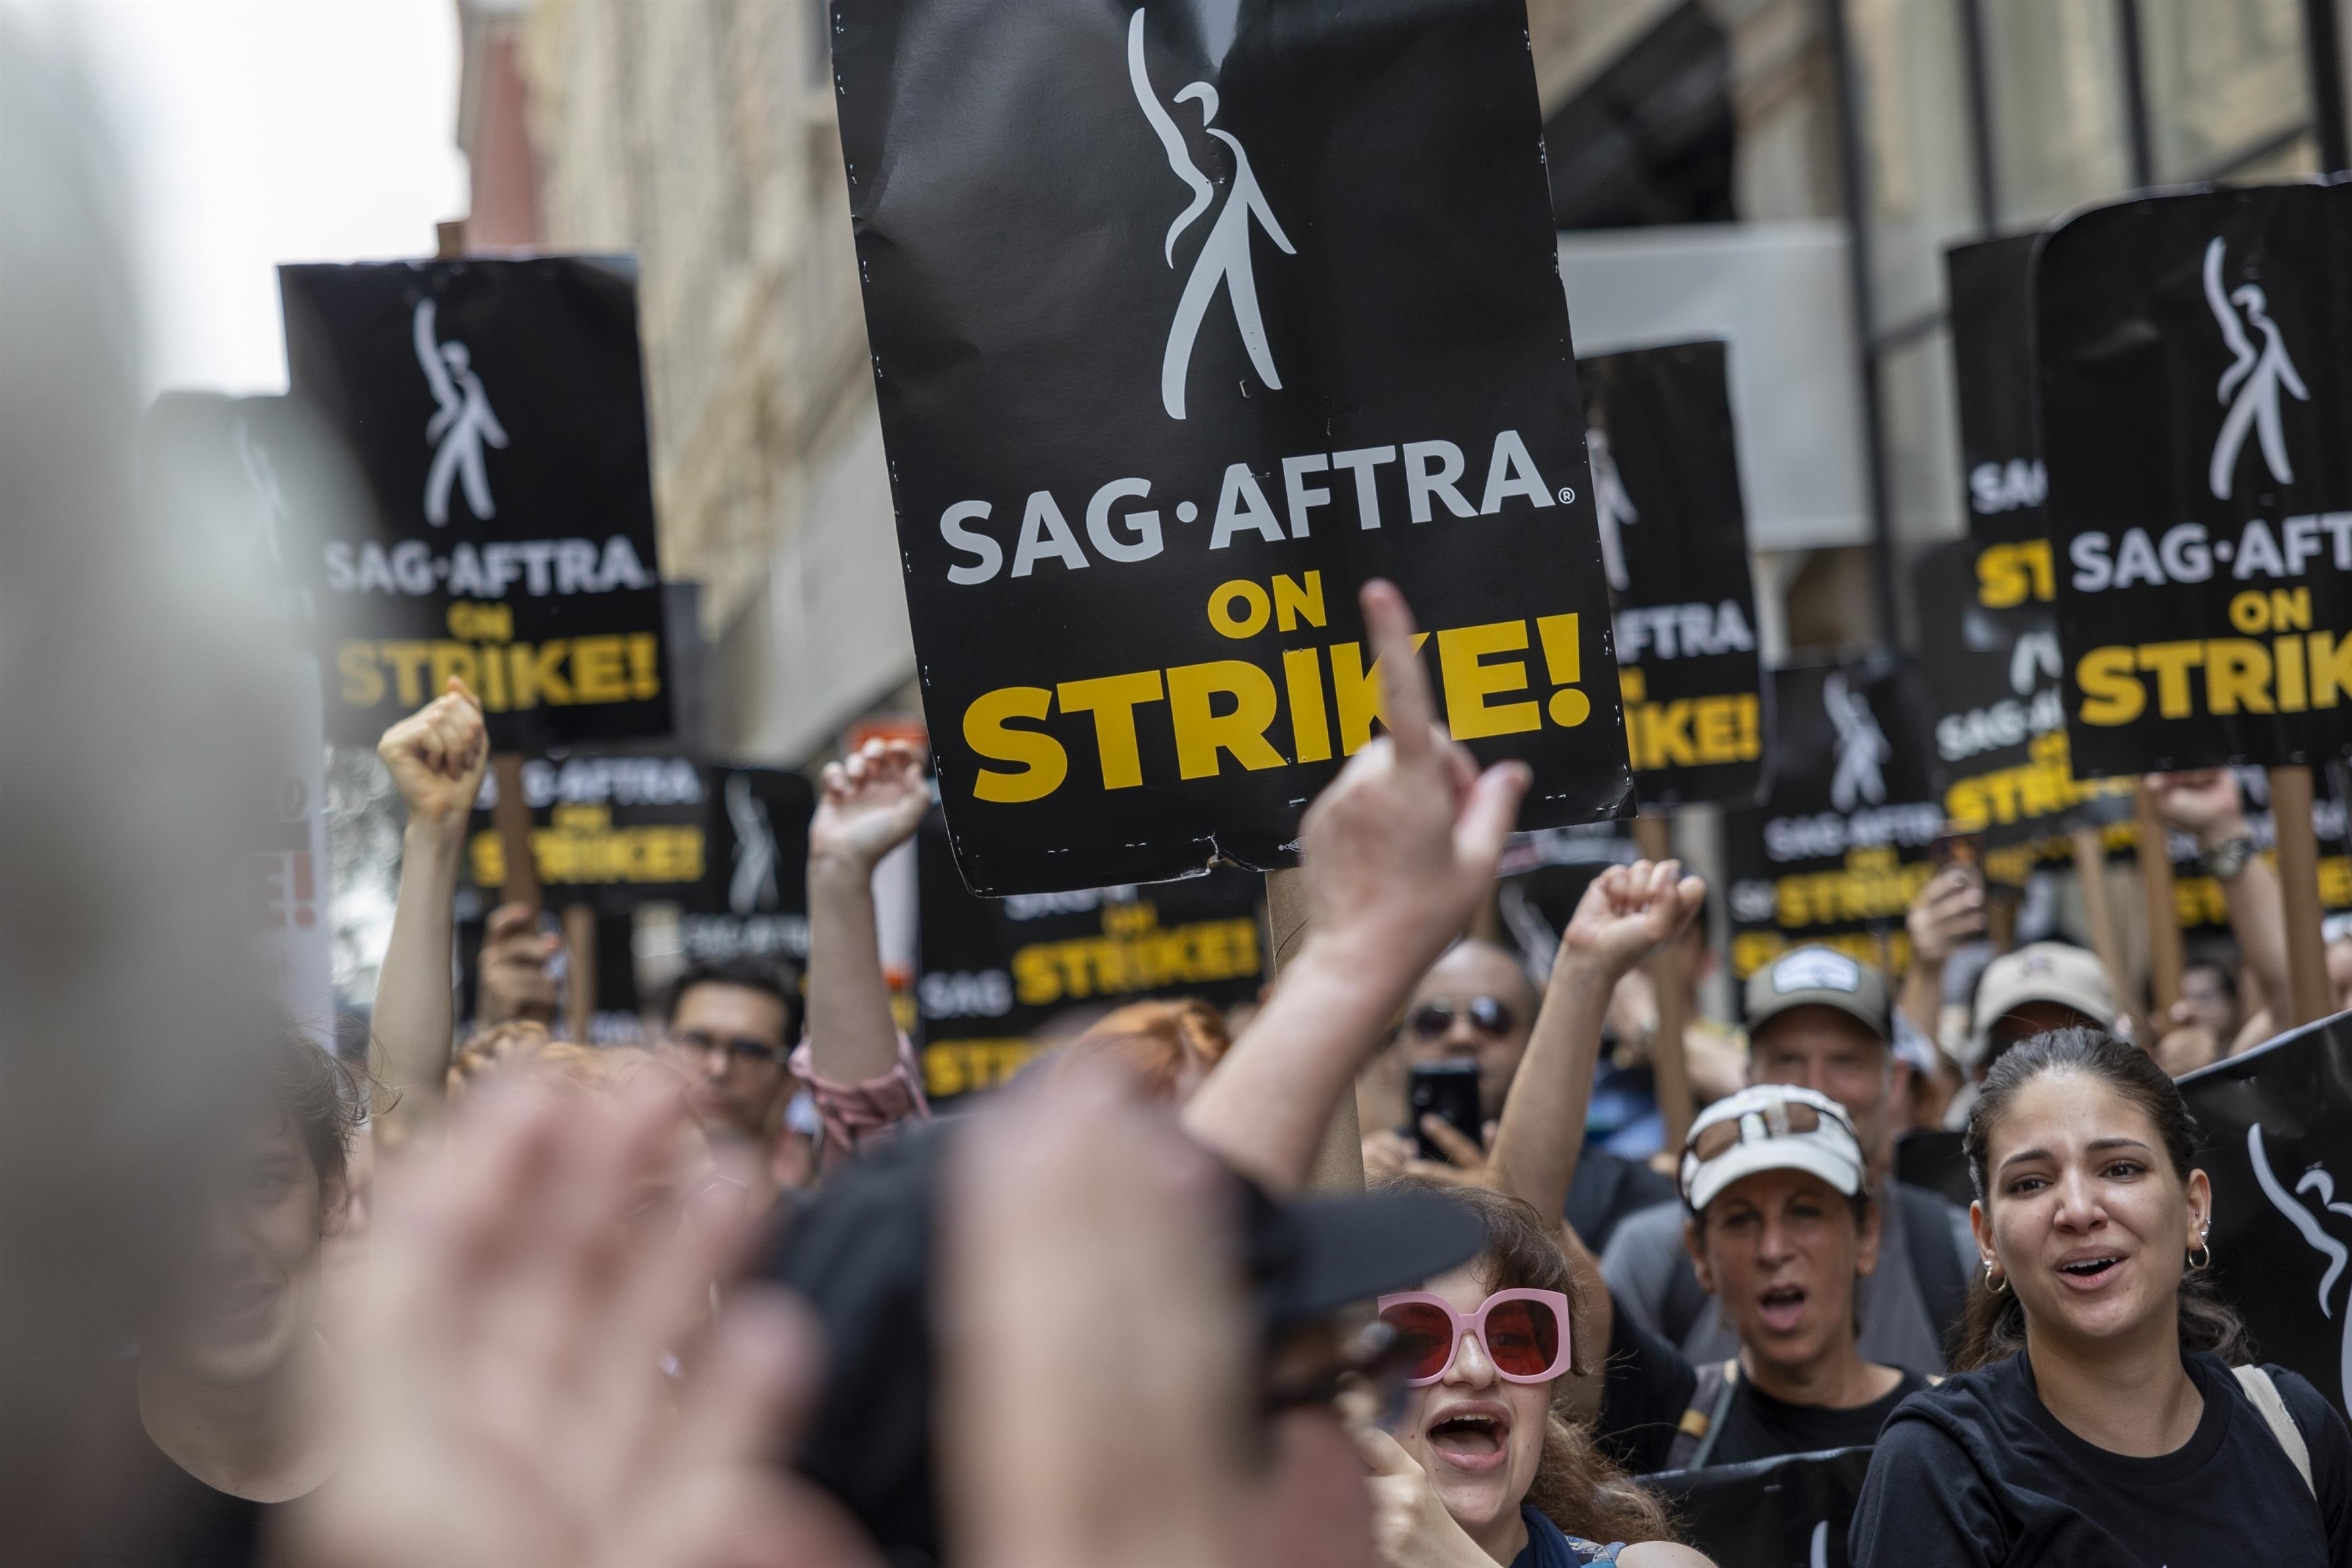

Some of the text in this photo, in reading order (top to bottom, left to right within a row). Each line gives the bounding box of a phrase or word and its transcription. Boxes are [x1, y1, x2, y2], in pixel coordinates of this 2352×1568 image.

[1207, 570, 1327, 639] ON
[2228, 586, 2312, 635] ON
[337, 632, 661, 713] STRIKE!
[962, 612, 1591, 803] STRIKE!
